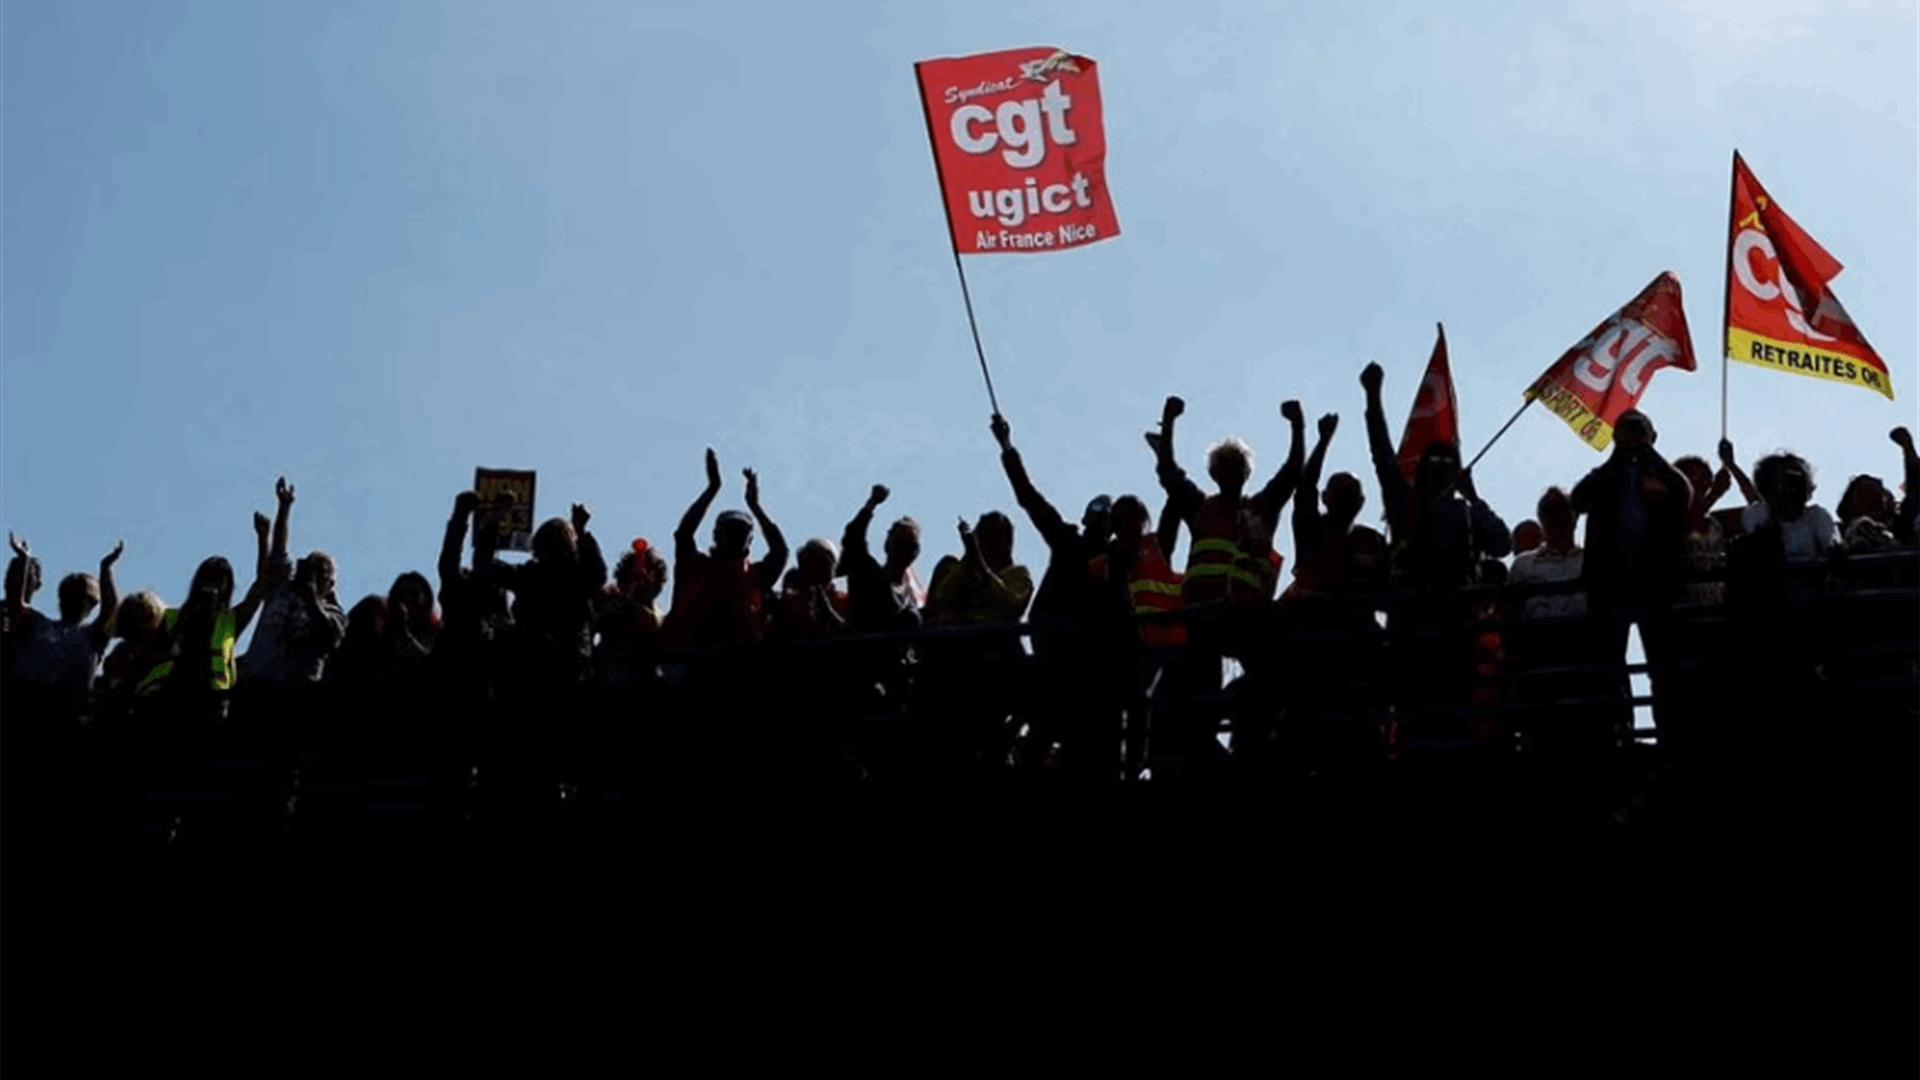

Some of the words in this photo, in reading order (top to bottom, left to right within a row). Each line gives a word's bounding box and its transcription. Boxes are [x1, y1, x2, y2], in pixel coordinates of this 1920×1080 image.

[944, 77, 1024, 104] Syndicat
[950, 79, 1077, 169] cgt
[967, 171, 1091, 226] ugict
[976, 230, 996, 249] Air
[1000, 227, 1054, 248] France
[1058, 222, 1096, 244] Nice
[1751, 341, 1857, 380] RETRAITÉS
